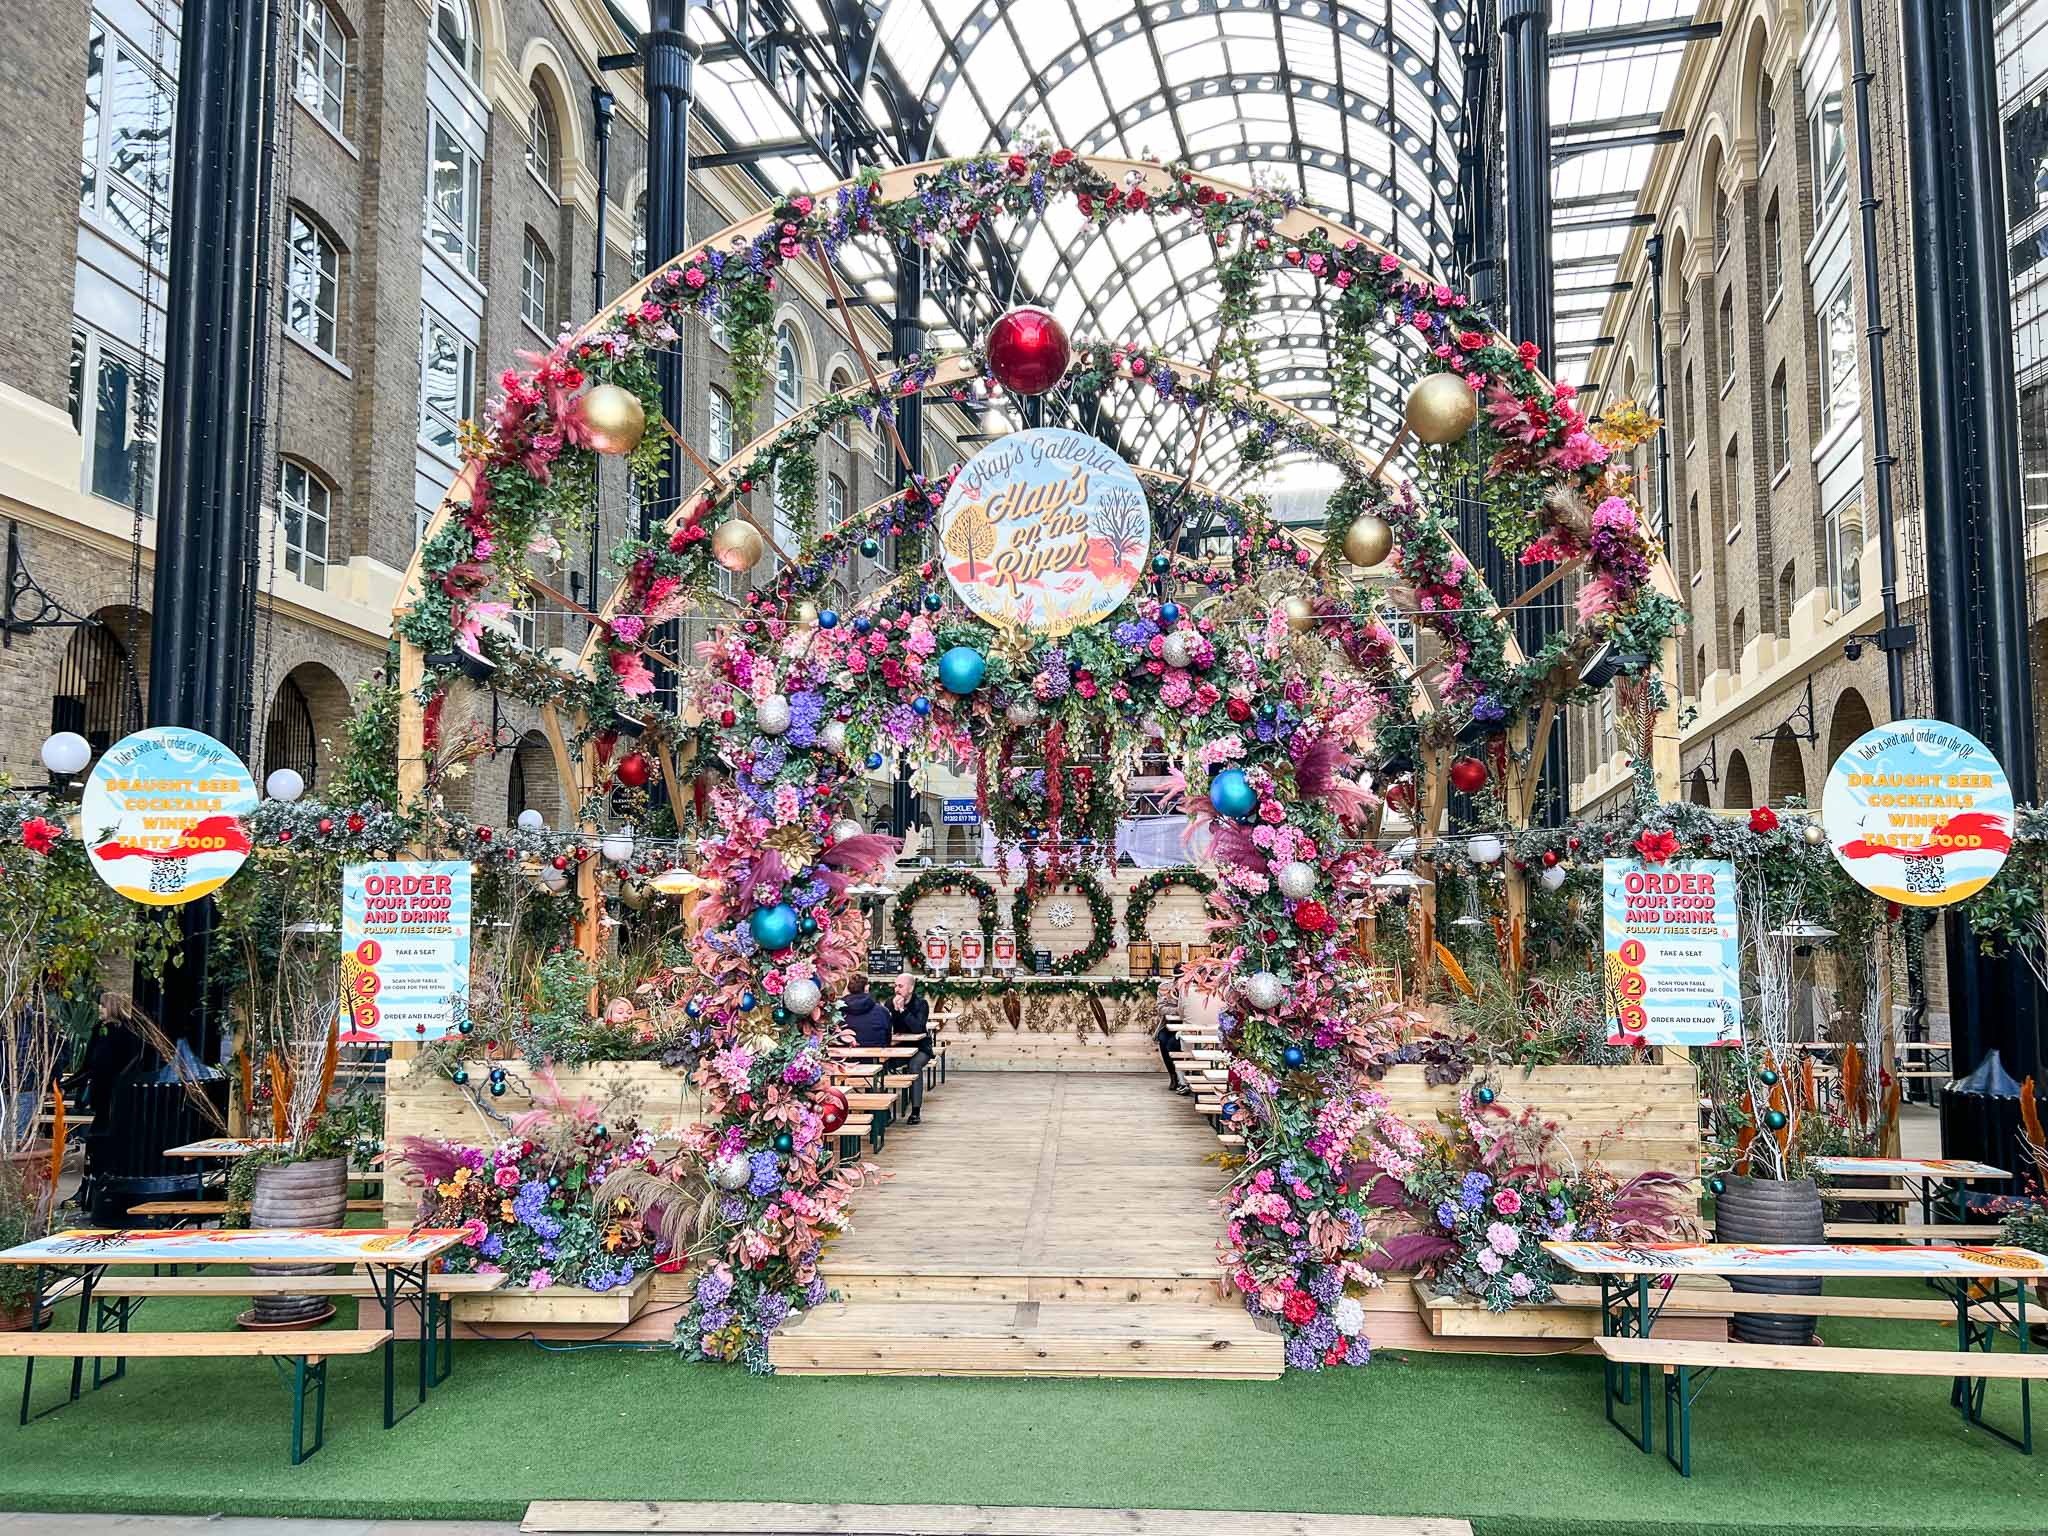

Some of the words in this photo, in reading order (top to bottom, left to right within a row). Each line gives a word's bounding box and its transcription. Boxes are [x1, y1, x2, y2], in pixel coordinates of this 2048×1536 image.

[967, 442, 1024, 490] Hay's
[1031, 436, 1115, 473] Galleria
[985, 464, 1089, 525] Hay's
[1010, 523, 1042, 548] on
[1047, 507, 1089, 538] the
[992, 532, 1089, 599] River
[113, 750, 133, 766] Take
[131, 748, 138, 757] a
[136, 741, 152, 754] seat
[152, 736, 166, 749] and
[166, 736, 186, 750] order
[187, 741, 197, 752] on
[197, 744, 210, 758] the
[1858, 745, 1879, 760] Take
[1877, 742, 1884, 751] a
[1883, 732, 1900, 749] seat
[1900, 728, 1915, 743] and
[1916, 728, 1937, 743] order
[1937, 735, 1947, 746] on
[1947, 737, 1961, 752] the
[1958, 743, 1975, 760] QR
[106, 779, 193, 792] DRAUGHT
[198, 779, 240, 792] BEER
[1848, 773, 1942, 787] DRAUGHT
[1947, 774, 1993, 788] BEER
[124, 798, 222, 811] COCKTAILS
[1867, 794, 1974, 808] COCKTAILS
[143, 817, 198, 830] WINES
[1888, 813, 1949, 828] WINES
[117, 835, 174, 849] TASTY
[178, 836, 226, 849] FOOD
[1862, 833, 1924, 847] TASTY
[1929, 834, 1982, 847] FOOD
[364, 875, 452, 895] ORDER
[1625, 873, 1715, 894] ORDER
[364, 897, 407, 909] YOUR
[410, 897, 451, 909] FOOD
[1624, 895, 1668, 908] YOUR
[1672, 896, 1715, 909] FOOD
[364, 911, 398, 923] AND
[401, 911, 450, 923] DRINK
[1625, 910, 1660, 922] AND
[1663, 910, 1715, 923] DRINK
[1626, 926, 1660, 934] FOLLOW
[1691, 927, 1718, 935] STEPS
[363, 944, 374, 960] 1
[1625, 944, 1637, 961] 1
[362, 976, 376, 993] 2
[1627, 977, 1641, 995] 2
[361, 1008, 375, 1025] 3
[1627, 1011, 1642, 1029] 3
